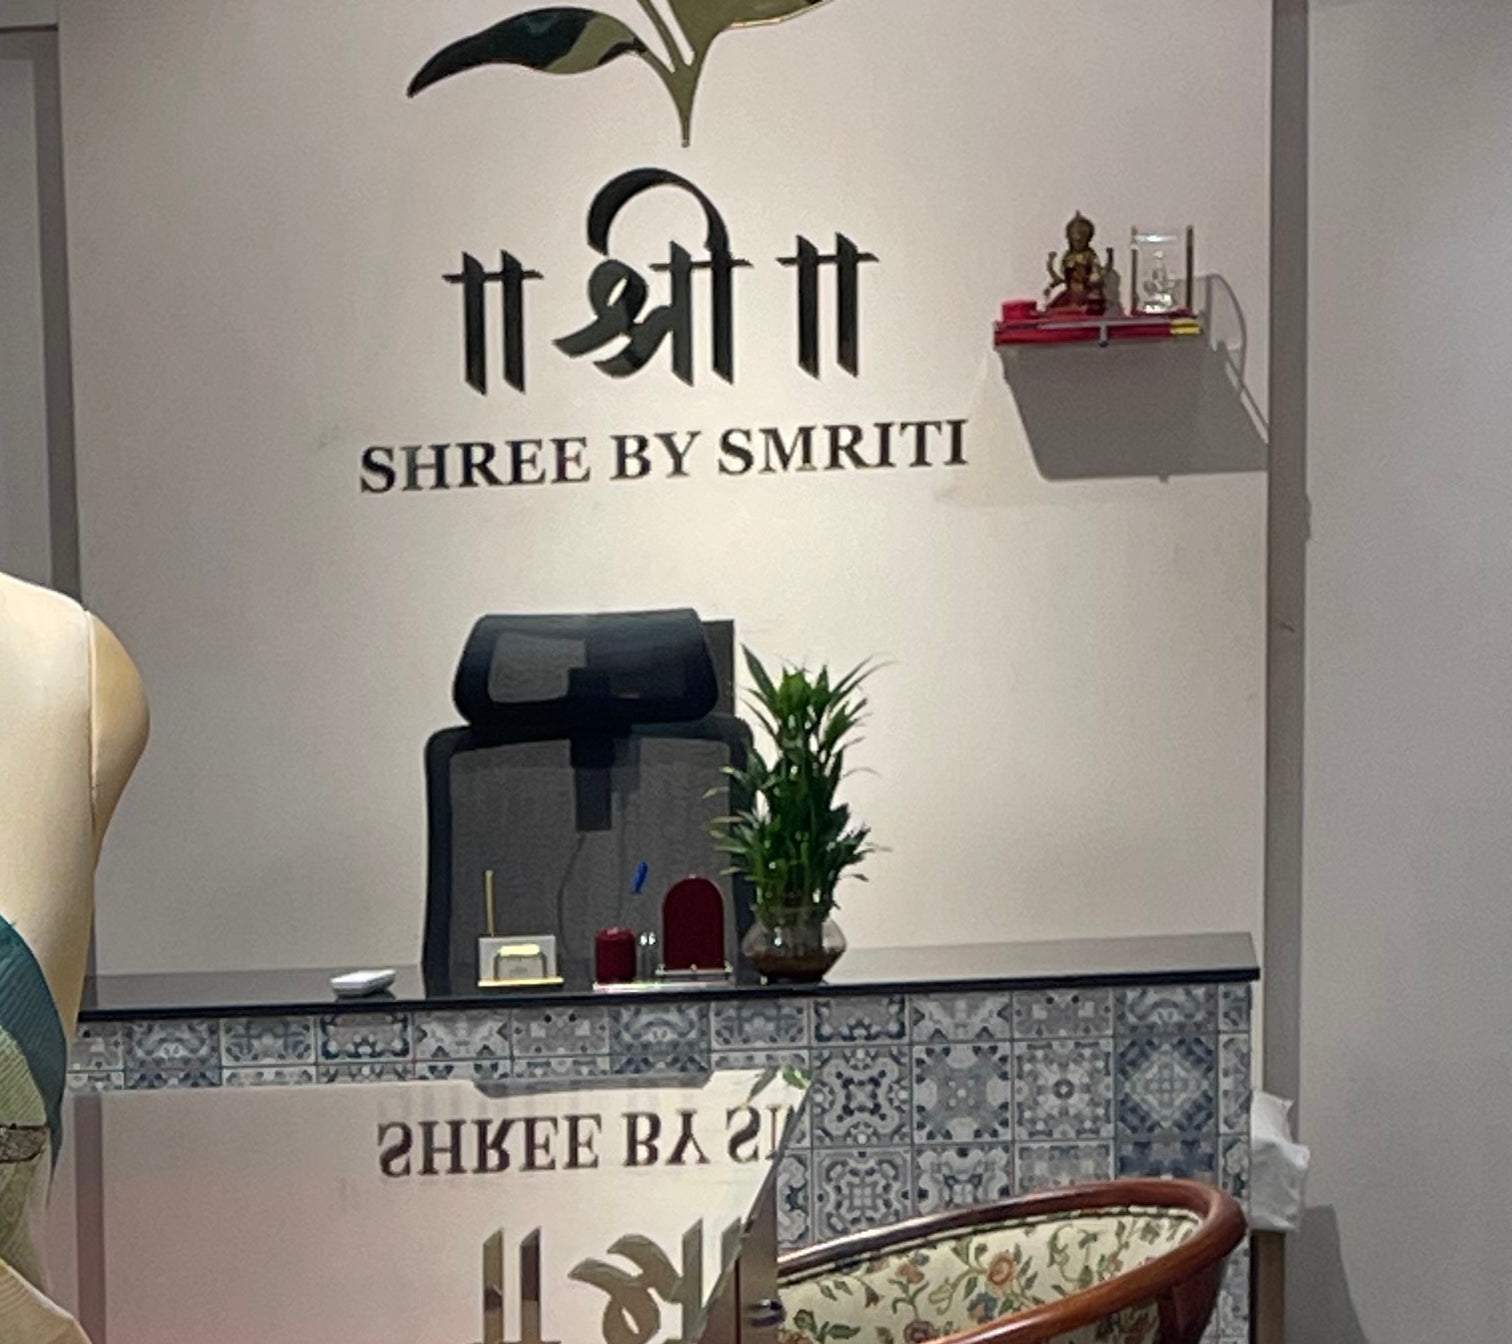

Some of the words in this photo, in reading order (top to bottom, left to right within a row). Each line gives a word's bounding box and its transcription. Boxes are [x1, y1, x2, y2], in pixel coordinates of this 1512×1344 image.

[552, 167, 754, 387] श्री
[359, 436, 591, 494] SHREE
[609, 431, 702, 481] BY
[717, 419, 969, 476] SMRITI
